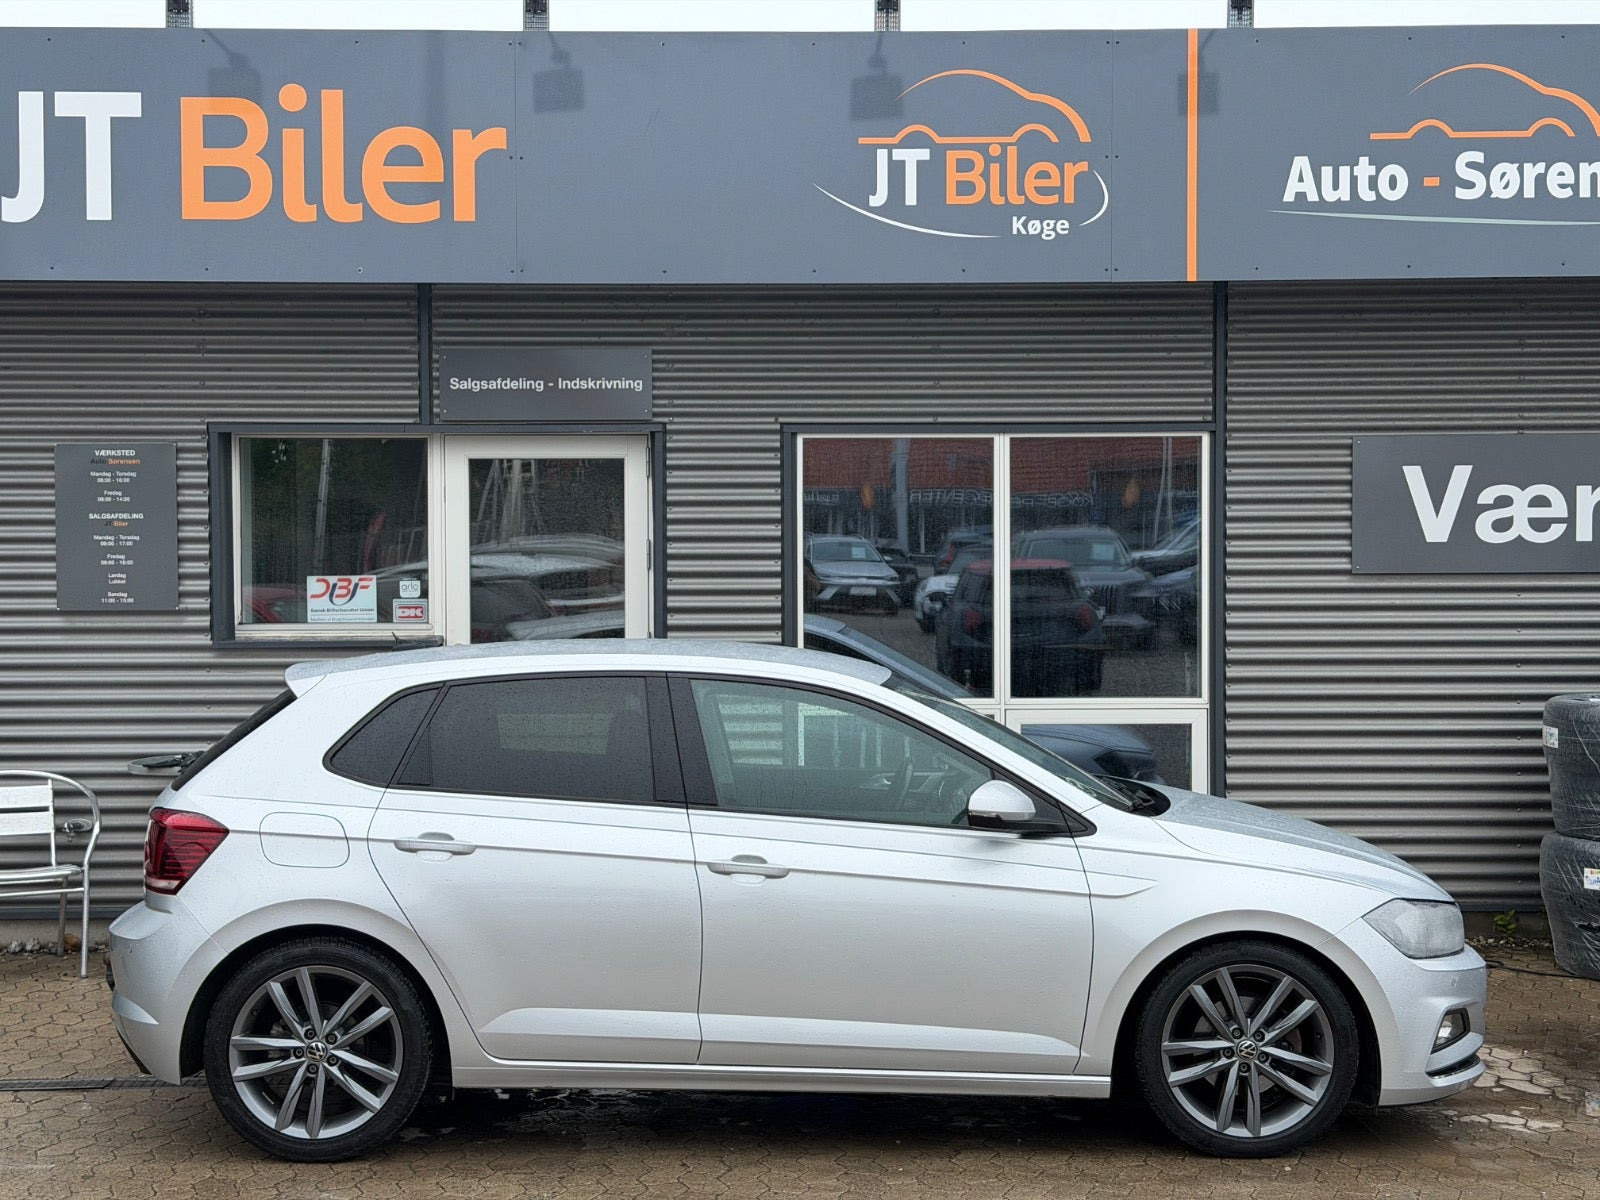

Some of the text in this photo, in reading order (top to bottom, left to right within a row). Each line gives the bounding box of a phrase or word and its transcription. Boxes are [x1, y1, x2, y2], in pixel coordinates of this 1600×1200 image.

[1, 84, 508, 223] JT Biler
[868, 144, 1089, 207] JT Biler
[1282, 155, 1409, 203] Auto
[1423, 177, 1440, 187] -
[1011, 215, 1070, 241] Køge
[449, 377, 544, 392] Salgsafdeling
[558, 377, 643, 392] Indskrivning
[94, 449, 136, 457] VÆRKSTED
[88, 512, 145, 520] SALGSAFDELING
